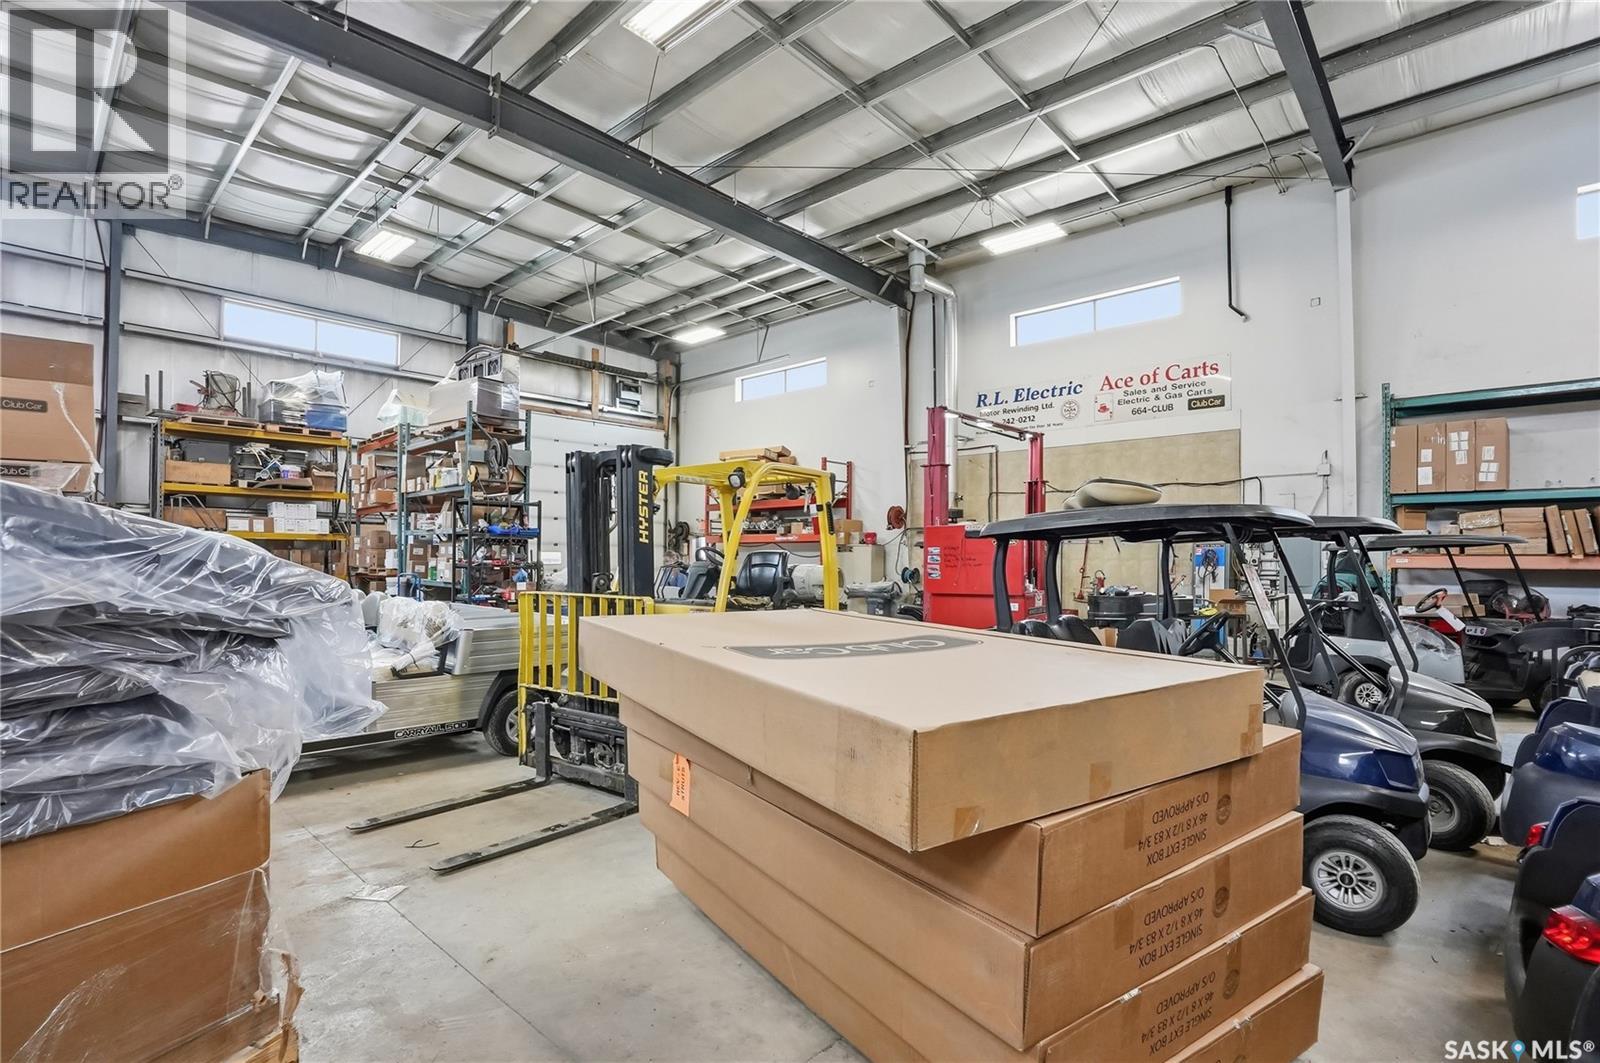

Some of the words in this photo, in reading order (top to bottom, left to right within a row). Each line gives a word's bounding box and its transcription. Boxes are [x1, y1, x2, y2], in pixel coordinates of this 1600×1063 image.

[1100, 375, 1134, 392] Ace
[1139, 367, 1160, 386] of
[1165, 361, 1219, 381] Carts
[976, 391, 1008, 408] R.L.
[1013, 381, 1083, 403] Electric
[1123, 387, 1147, 397] Sales
[1151, 384, 1167, 393] and
[1171, 380, 1206, 391] Service
[1117, 395, 1150, 406] Electric
[1164, 392, 1183, 400] Gas
[1186, 388, 1213, 397] Carts
[1002, 404, 1039, 415] Rewinding
[1041, 402, 1055, 410] Ltd.
[1131, 403, 1174, 416] 664-CLUB
[639, 470, 649, 544] HYSTER
[394, 724, 445, 739] CARRYALL
[1152, 797, 1195, 825] APPROVED
[1199, 811, 1208, 824] 46
[1172, 822, 1184, 837] 1/2
[1185, 818, 1192, 831] 8
[1192, 815, 1198, 829] X
[1153, 830, 1164, 845] 83
[1165, 827, 1171, 839] X
[1182, 828, 1207, 850] SINGLE
[1137, 835, 1152, 852] 3/4
[1165, 841, 1180, 858] EXT
[1146, 848, 1164, 866] BOX
[1143, 895, 1190, 926] APPROVED
[1187, 911, 1193, 924] X
[1194, 907, 1204, 920] 46
[1165, 920, 1178, 936] 1/2
[1180, 915, 1186, 928] 8
[1146, 931, 1157, 946] 83
[1158, 927, 1164, 939] X
[1176, 923, 1203, 949] SINGLE
[1129, 937, 1144, 955] 3/4
[1159, 939, 1174, 959] EXT
[1138, 949, 1157, 969] BOX
[1156, 982, 1201, 1015] APPROVED
[1198, 997, 1204, 1008] X
[1204, 991, 1214, 1005] 46
[1177, 1005, 1189, 1021] 1/2
[1191, 1000, 1197, 1013] 8
[1157, 1018, 1167, 1034] 83
[1169, 1015, 1175, 1026] X
[1185, 1006, 1212, 1033] SINGLE
[1141, 1025, 1155, 1044] 3/4
[1168, 1024, 1184, 1044] EXT
[1149, 1034, 1167, 1057] BOX
